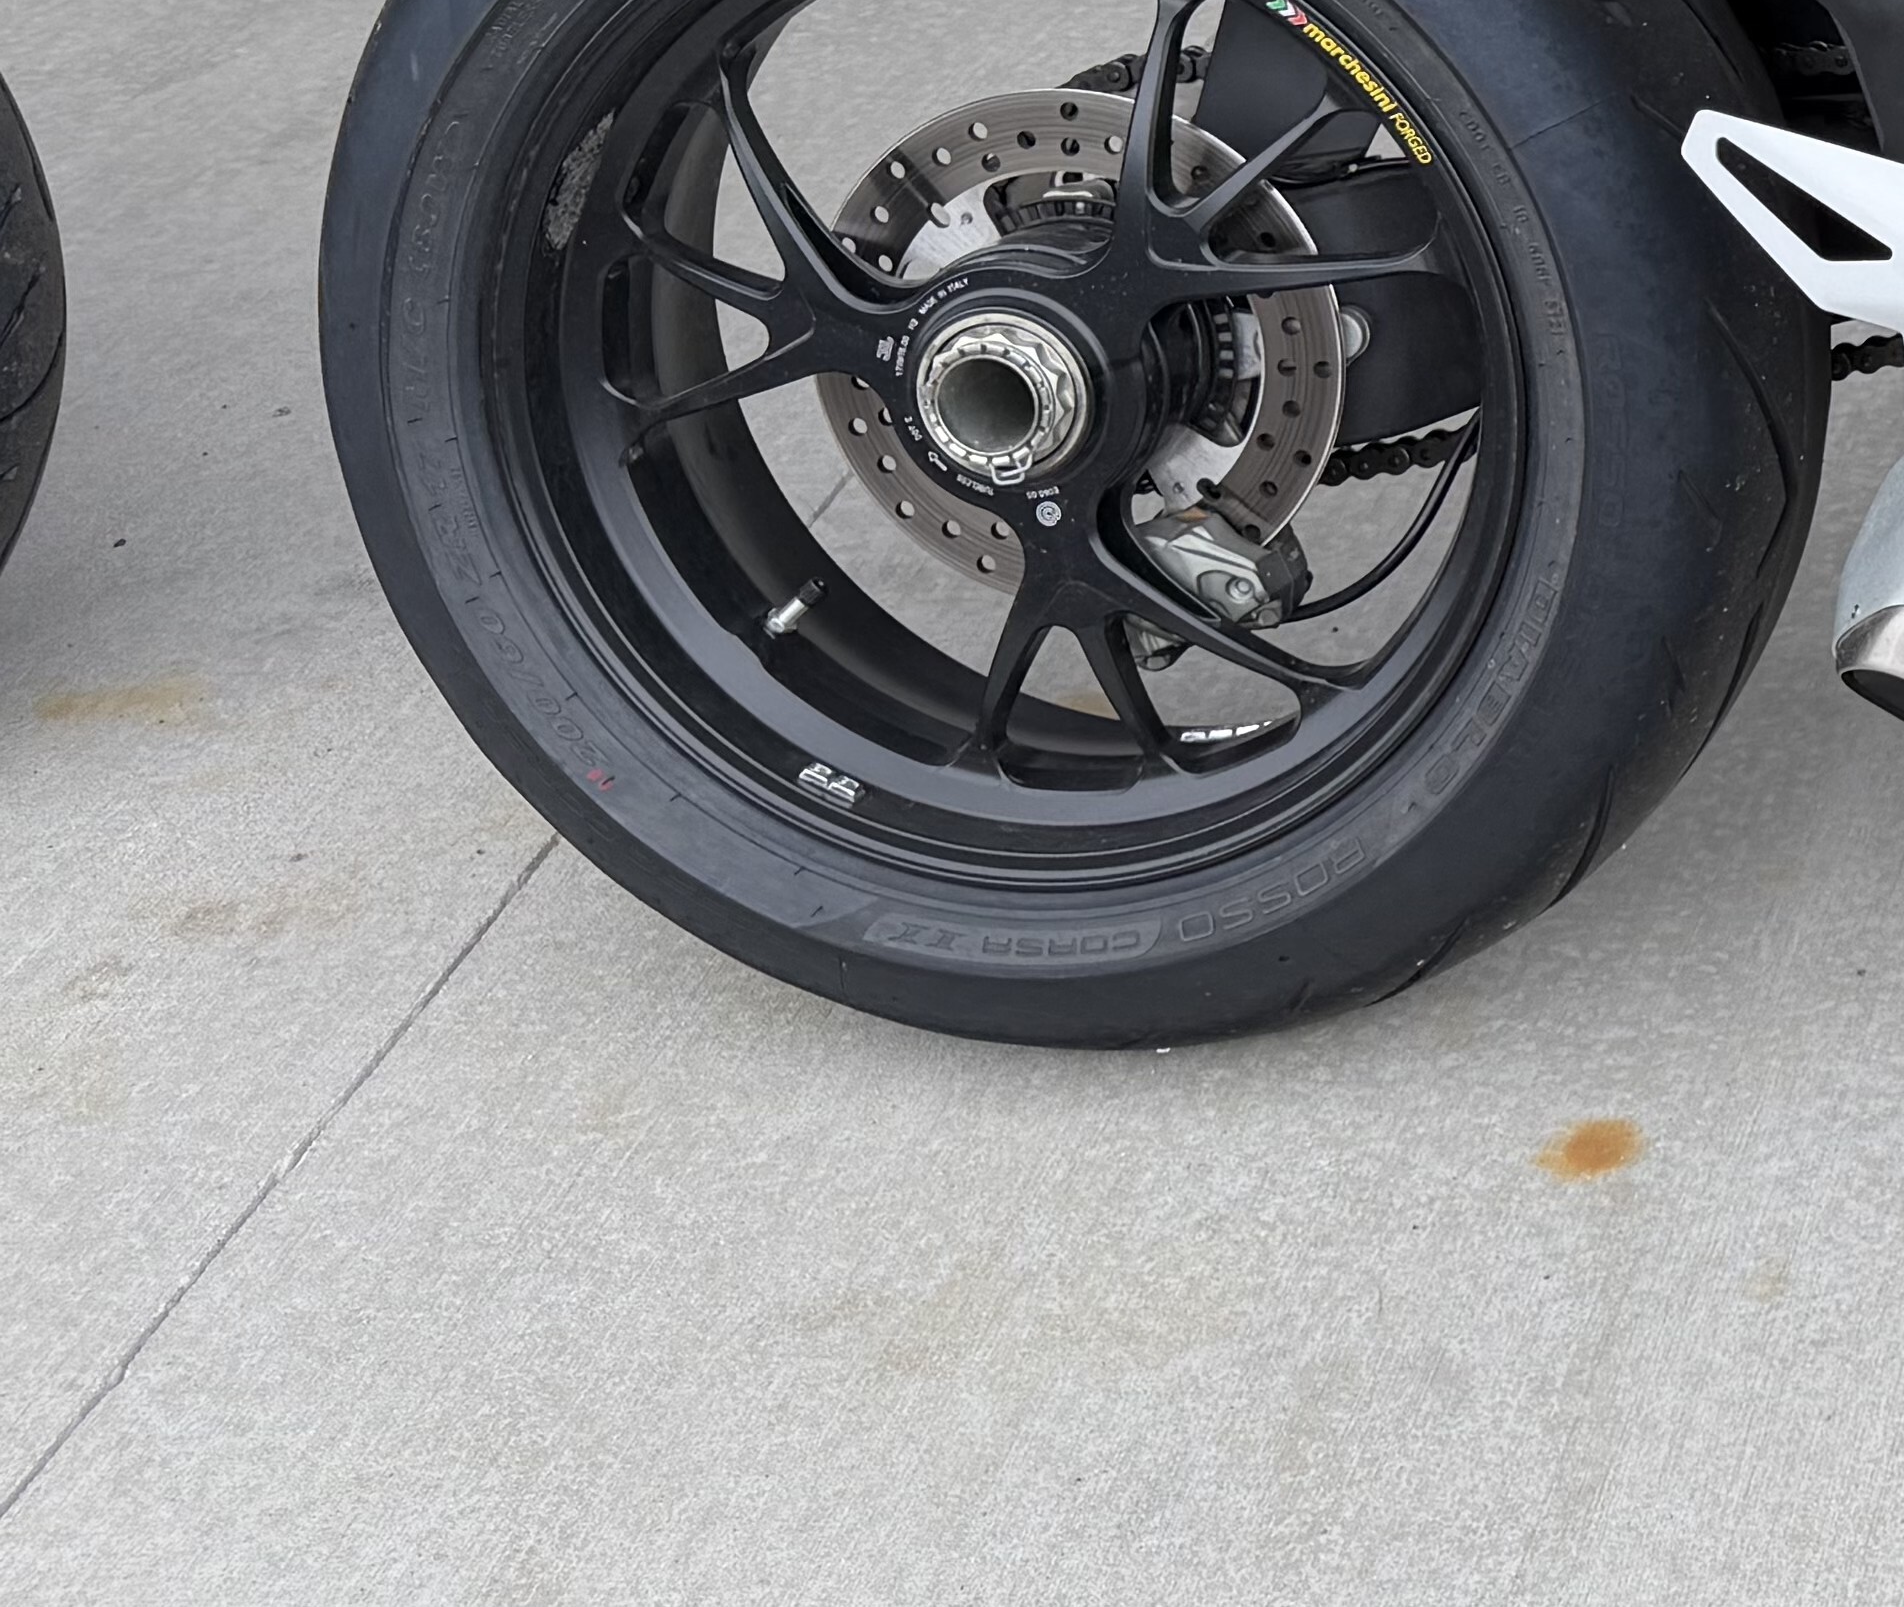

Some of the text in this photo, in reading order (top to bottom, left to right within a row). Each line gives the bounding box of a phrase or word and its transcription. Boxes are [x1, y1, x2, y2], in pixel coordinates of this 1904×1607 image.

[1302, 22, 1398, 114] marchesini
[1390, 110, 1433, 165] FORGED
[1423, 578, 1557, 796] DIABLO
[980, 930, 1142, 960] CORSA
[1177, 839, 1367, 942] ROSSO
